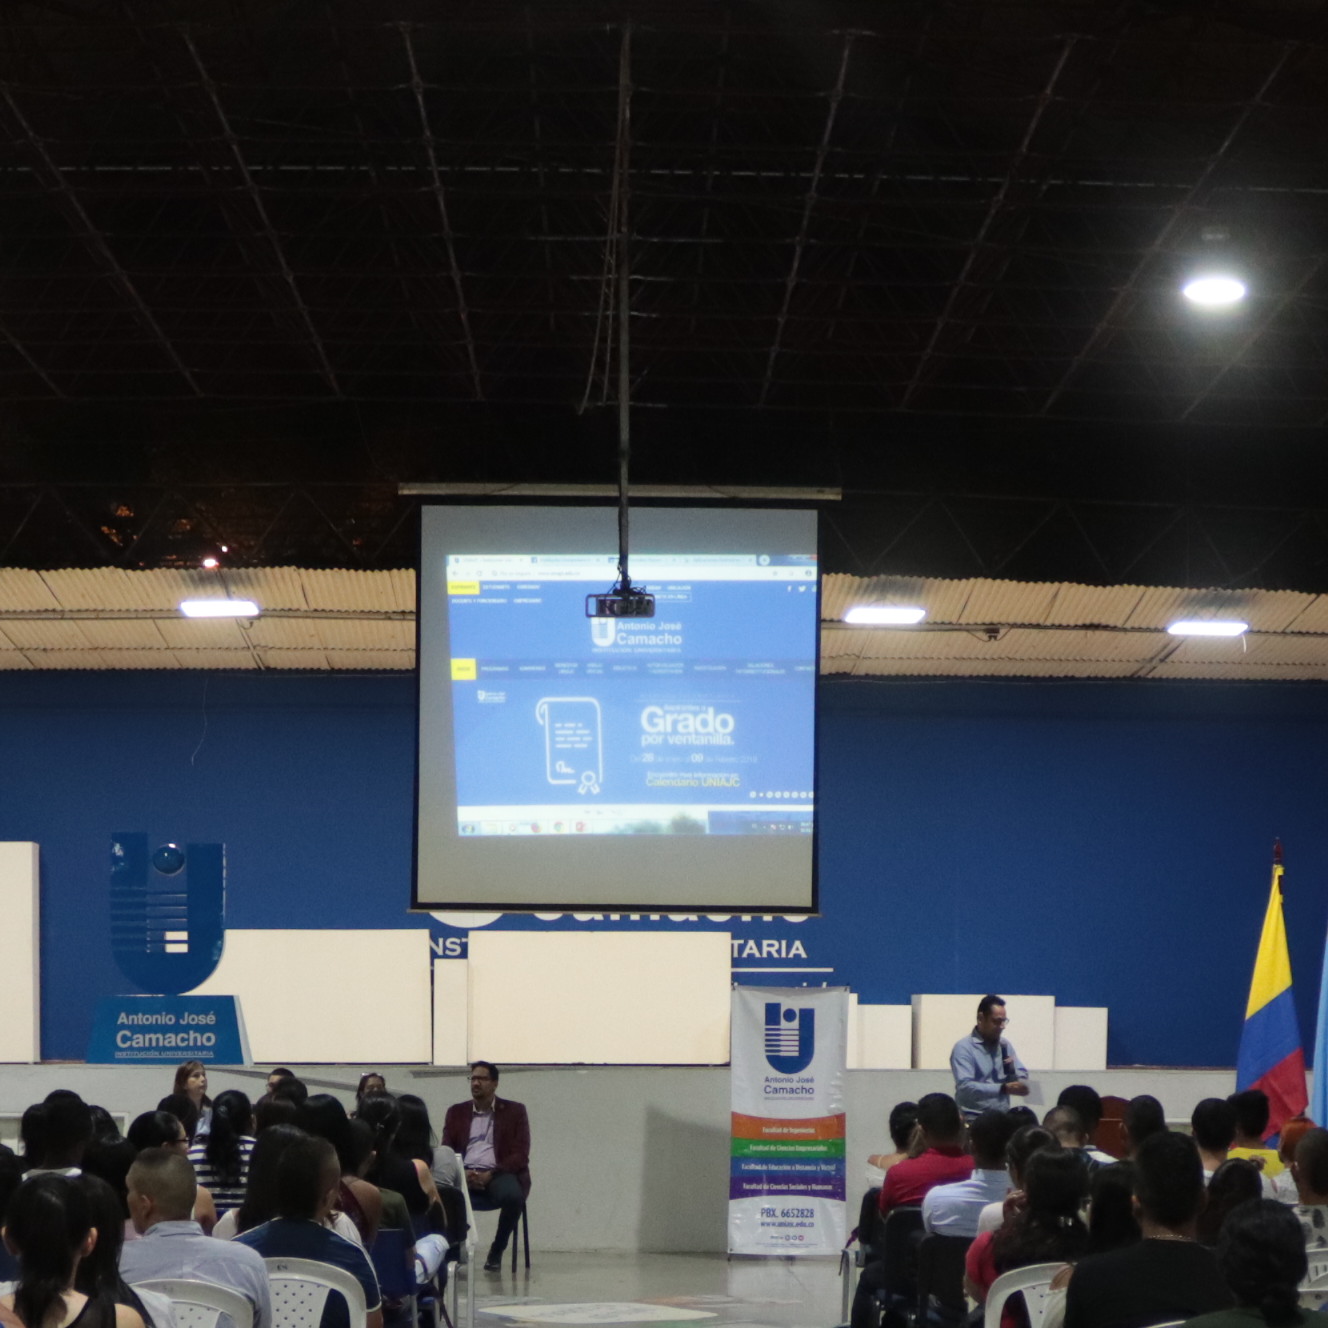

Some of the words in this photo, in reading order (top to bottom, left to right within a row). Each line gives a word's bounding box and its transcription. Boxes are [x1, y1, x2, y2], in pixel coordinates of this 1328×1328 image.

[616, 621, 656, 631] Antonio
[658, 621, 682, 631] José
[616, 632, 682, 646] Camacho
[640, 705, 735, 734] Grado
[641, 734, 664, 747] por
[667, 733, 735, 746] ventanilla.
[701, 777, 741, 787] UNIAJC
[117, 1011, 176, 1025] Antonio
[179, 1011, 216, 1025] José
[116, 1030, 216, 1048] Camacho
[115, 1049, 160, 1057] INSTITUCIÓN
[764, 1084, 815, 1095] Camacho
[760, 1208, 779, 1218] PBX.
[780, 1207, 815, 1218] 6652828
